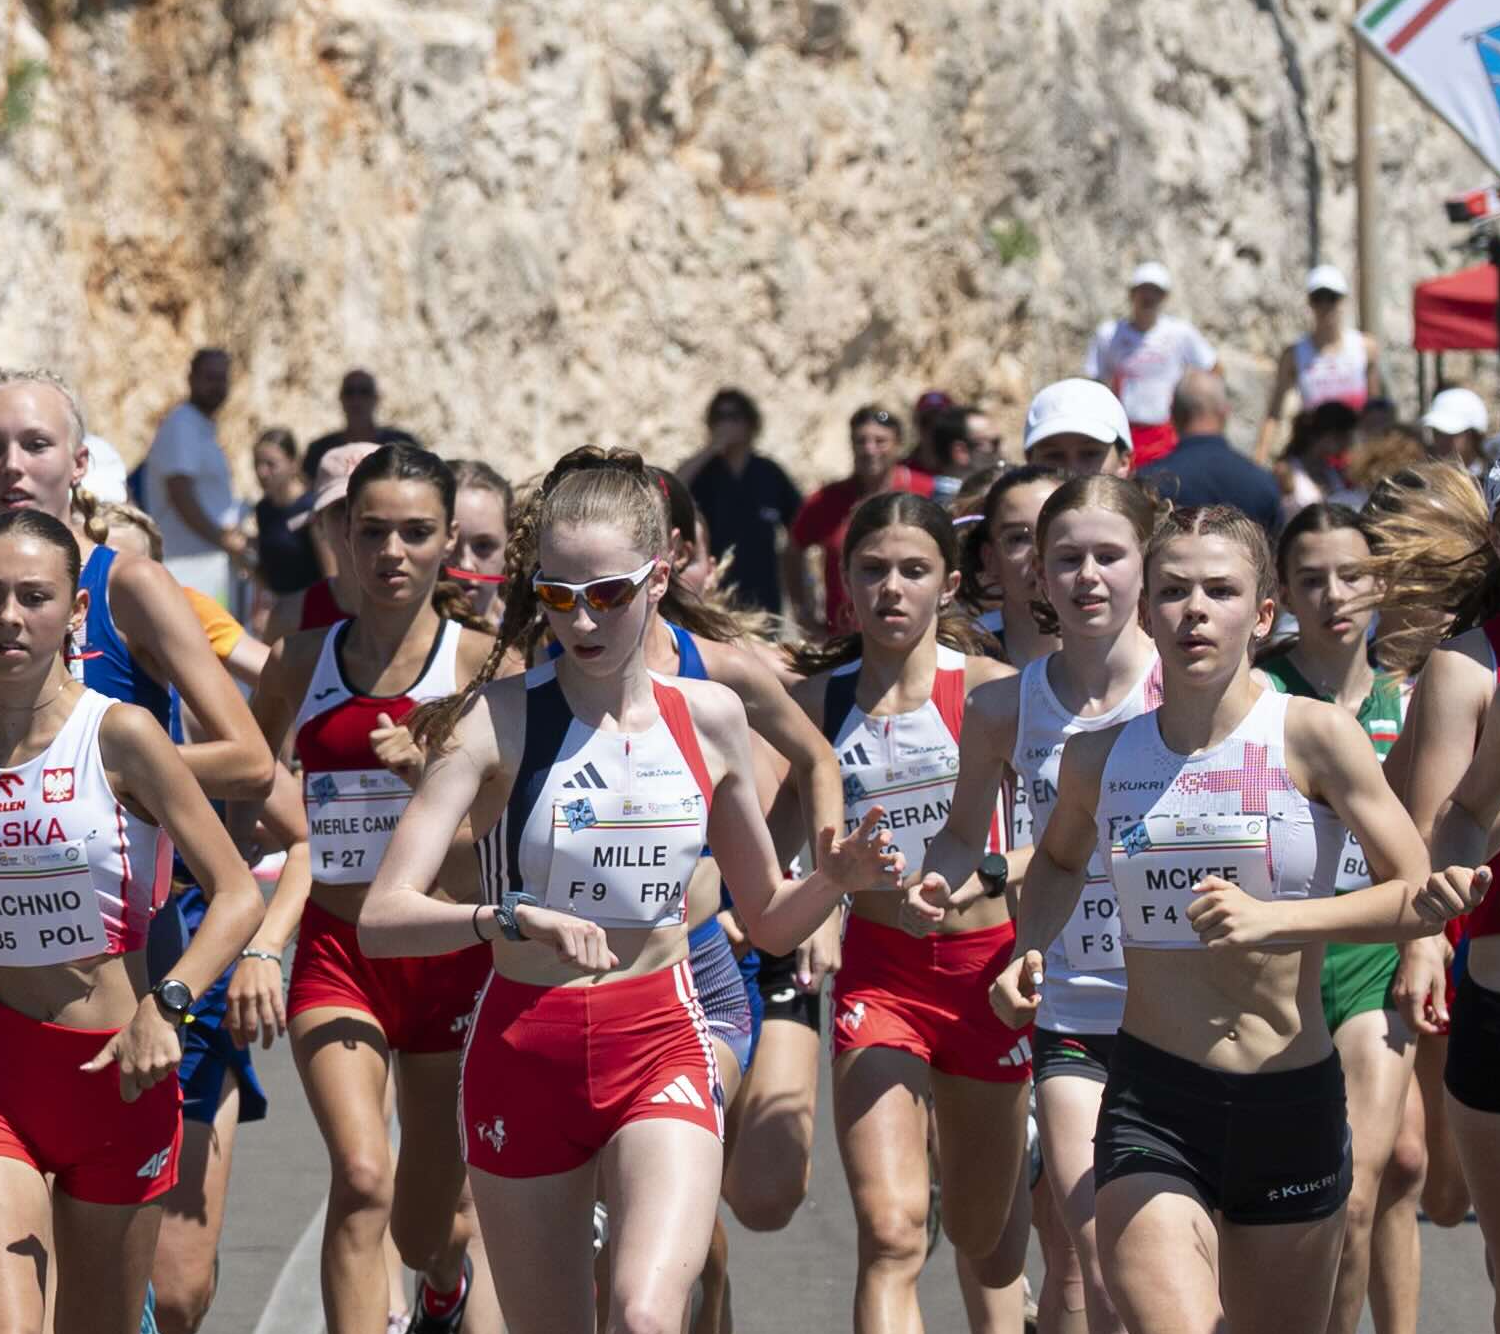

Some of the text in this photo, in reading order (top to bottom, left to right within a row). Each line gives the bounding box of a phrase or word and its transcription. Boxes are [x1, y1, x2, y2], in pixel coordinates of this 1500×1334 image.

[1119, 780, 1164, 791] KUKRI
[312, 818, 359, 835] MERLE
[322, 850, 365, 868] F 27
[593, 846, 667, 868] MILLE
[1146, 867, 1238, 890] MCKEE
[570, 881, 682, 903] F 9 FRA
[1084, 898, 1118, 918] FO
[1142, 906, 1178, 924] F 4
[39, 924, 94, 948] POL
[1082, 935, 1093, 953] F
[1282, 1173, 1336, 1197] KUKRI
